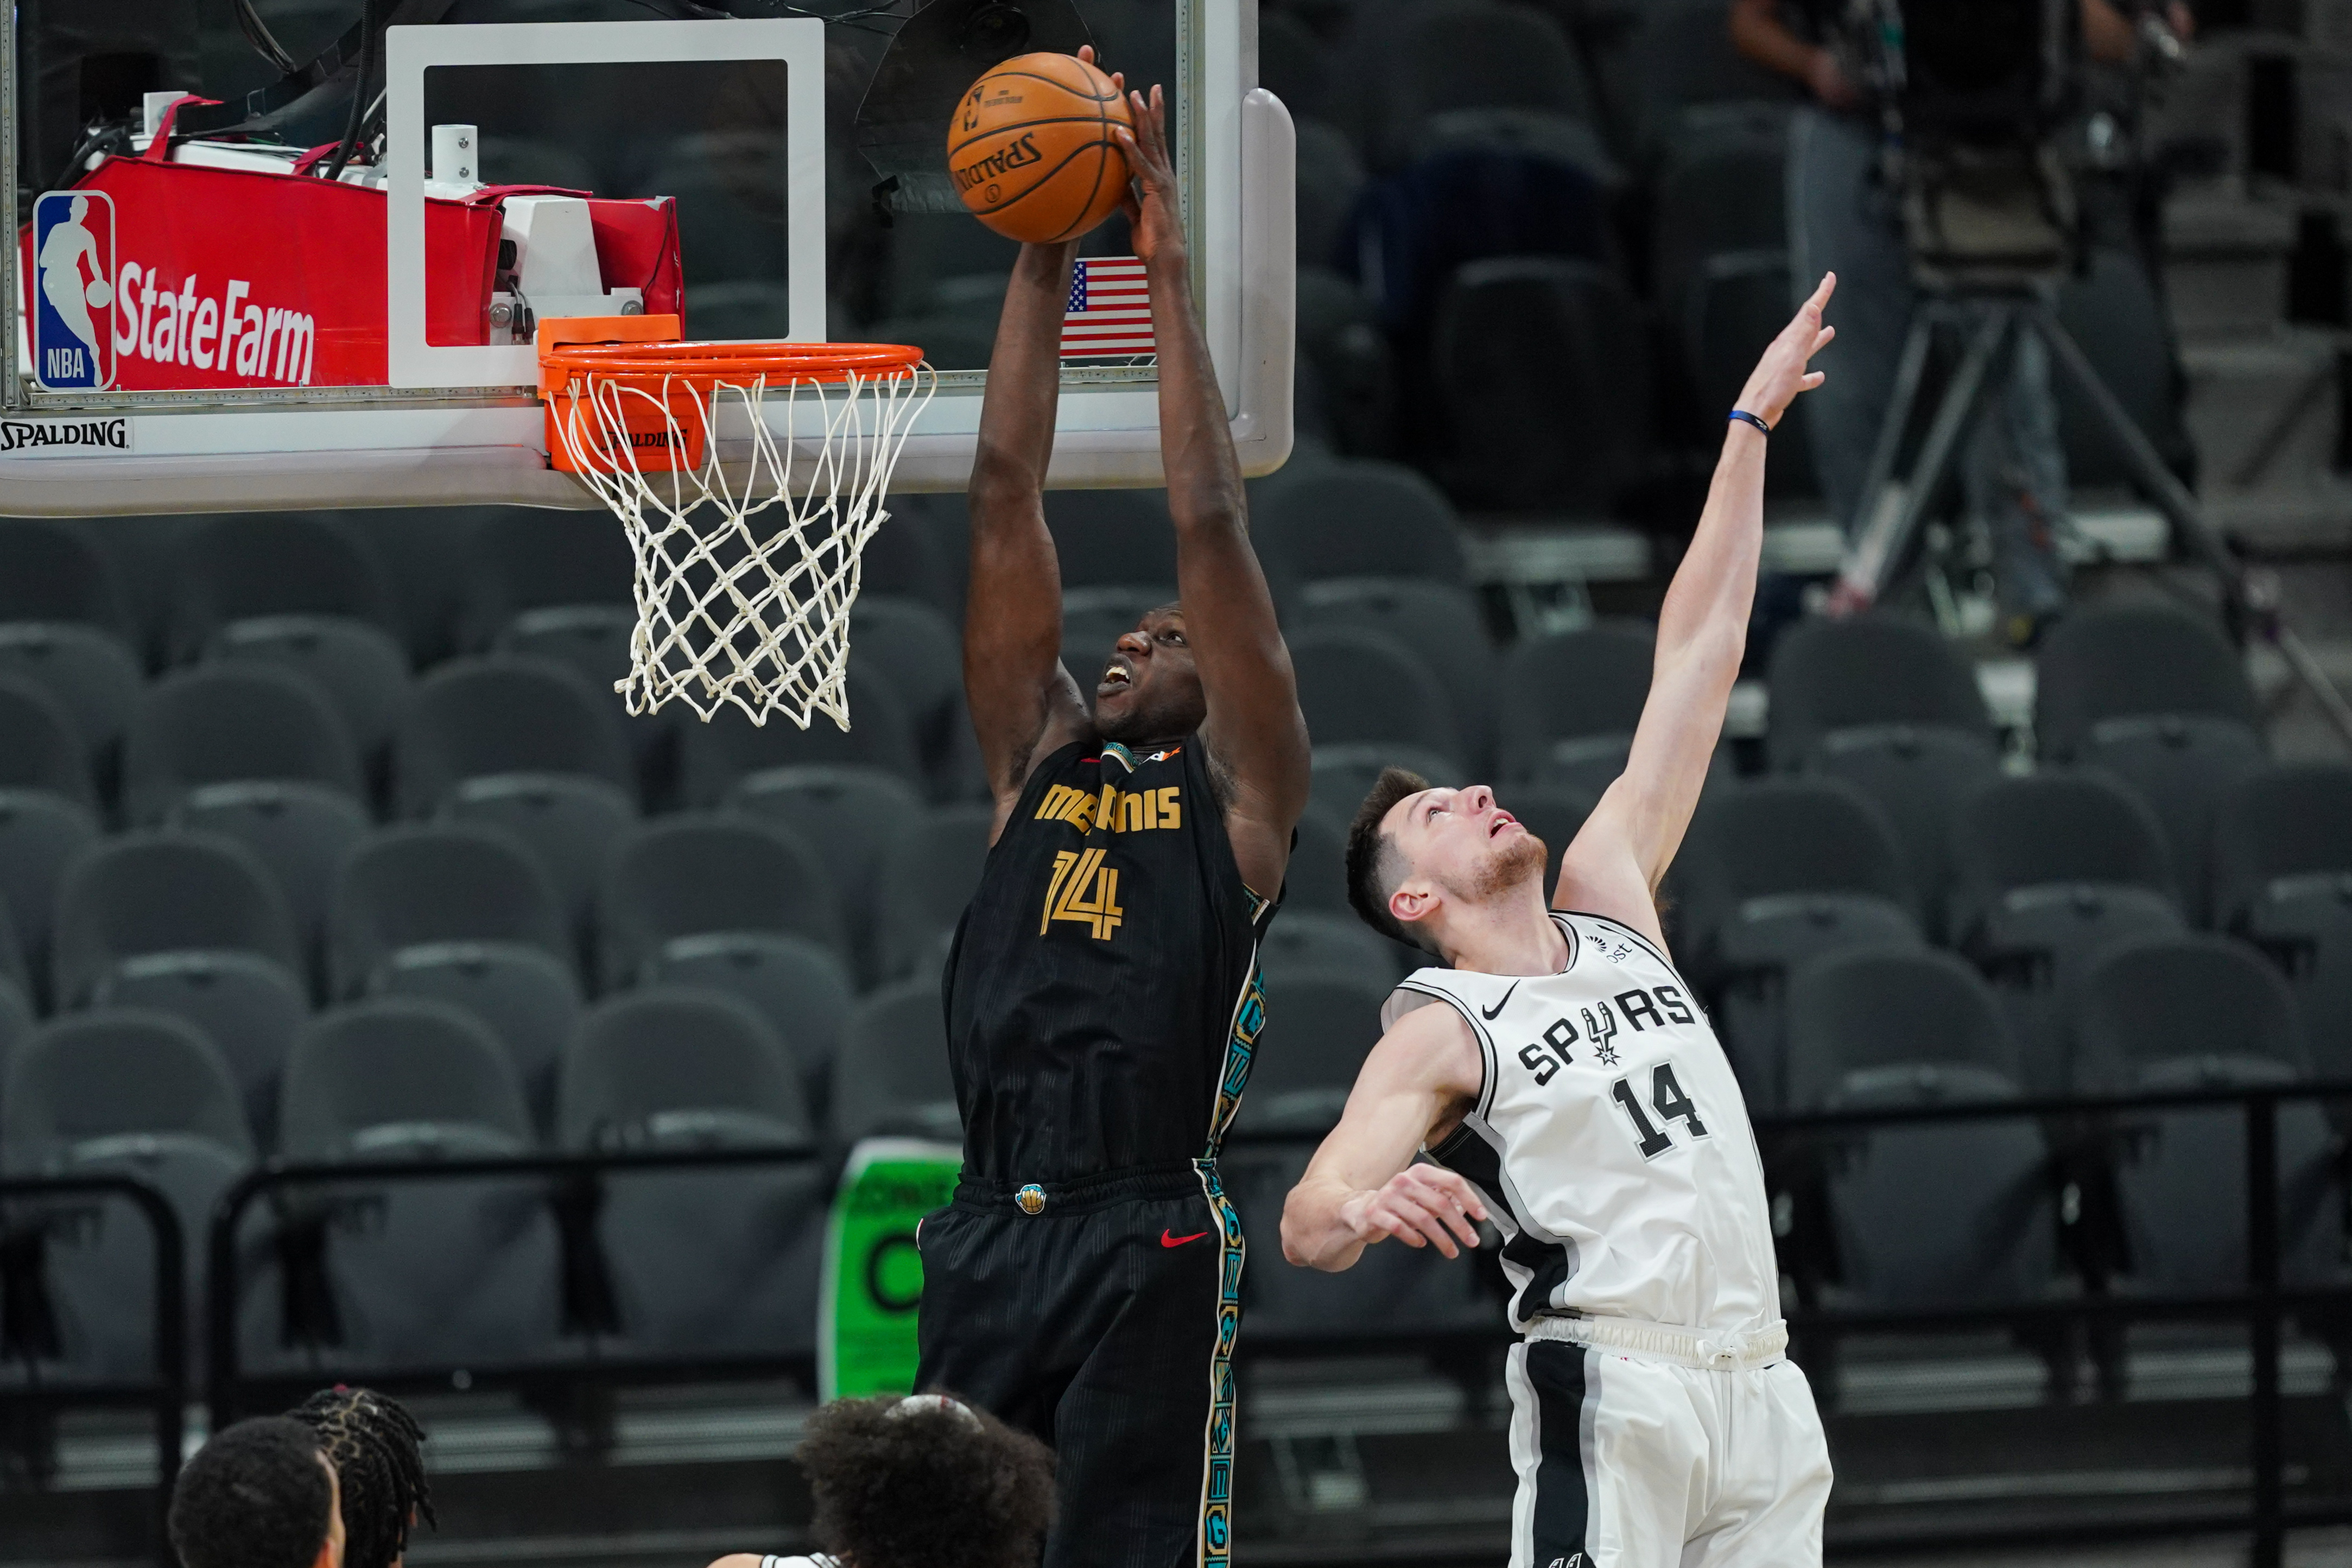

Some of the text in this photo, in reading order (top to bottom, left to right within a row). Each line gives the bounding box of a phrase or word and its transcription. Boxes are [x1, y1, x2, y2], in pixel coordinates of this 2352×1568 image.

[47, 348, 85, 378] NBA
[1, 418, 125, 451] SPALDING
[1039, 848, 1124, 941] 14
[1606, 943, 1633, 963] ost
[1518, 986, 1696, 1086] SPURS
[1608, 1059, 1713, 1163] 14
